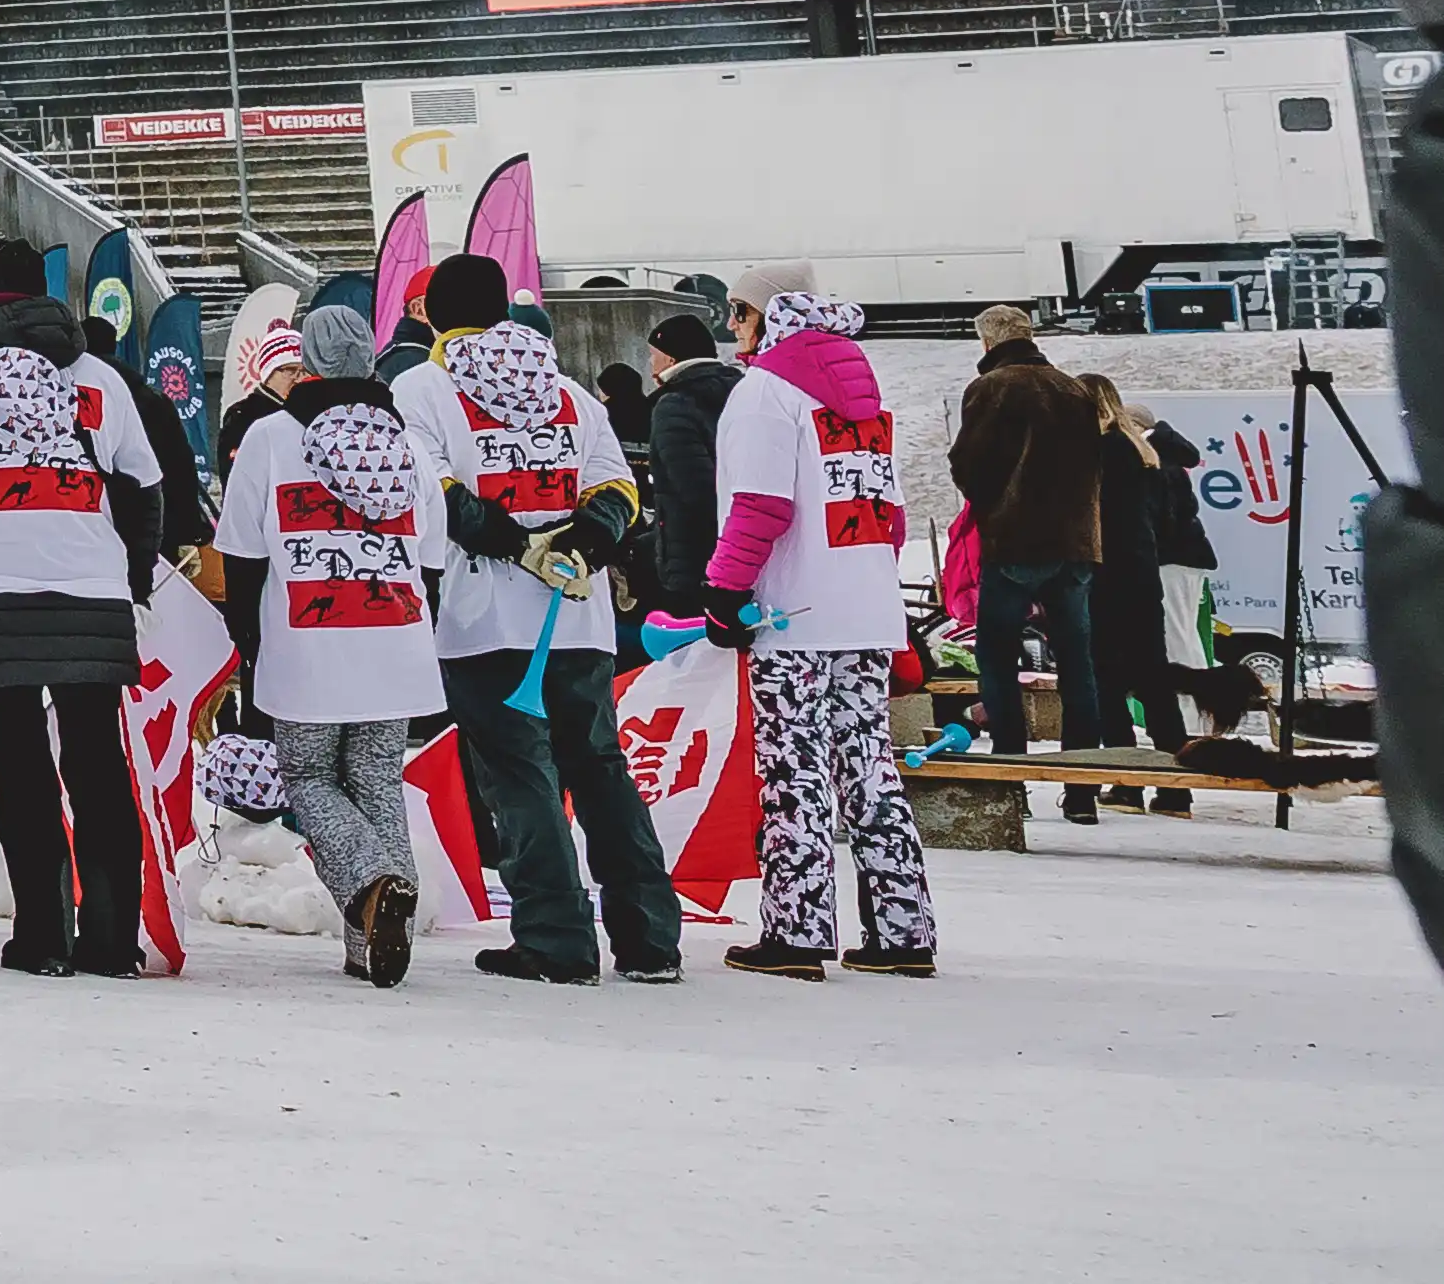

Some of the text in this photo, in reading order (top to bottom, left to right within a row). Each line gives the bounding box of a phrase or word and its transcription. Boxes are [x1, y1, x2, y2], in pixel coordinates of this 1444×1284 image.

[1383, 58, 1432, 86] GD
[130, 117, 222, 136] VEIDEKKE
[267, 112, 364, 131] VEIDEKKE
[1325, 565, 1364, 586] Tel
[1245, 597, 1278, 608] Para
[1310, 590, 1367, 610] Karu
